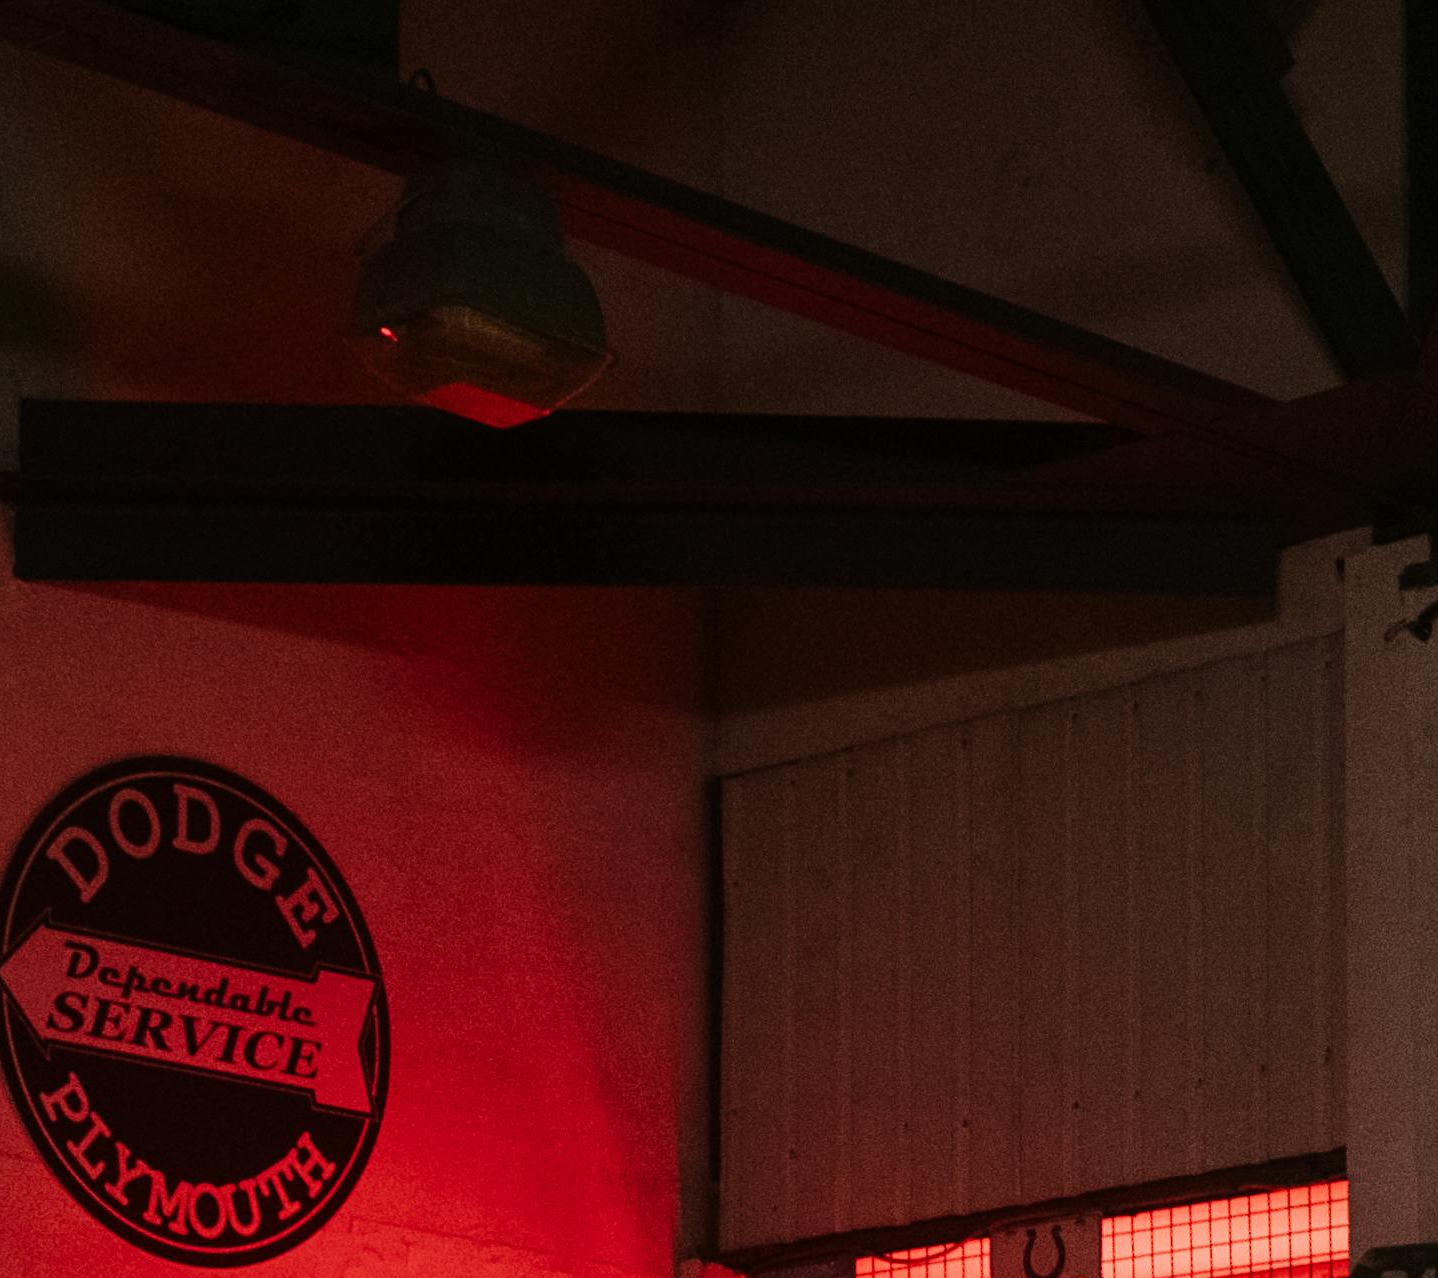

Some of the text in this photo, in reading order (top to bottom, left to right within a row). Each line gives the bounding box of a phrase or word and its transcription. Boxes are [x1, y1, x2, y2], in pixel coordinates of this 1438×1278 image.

[46, 783, 340, 950] DODGE
[46, 990, 324, 1081] SERVICE
[64, 941, 318, 1027] Dependable
[39, 1071, 337, 1238] PLYMOUTH
